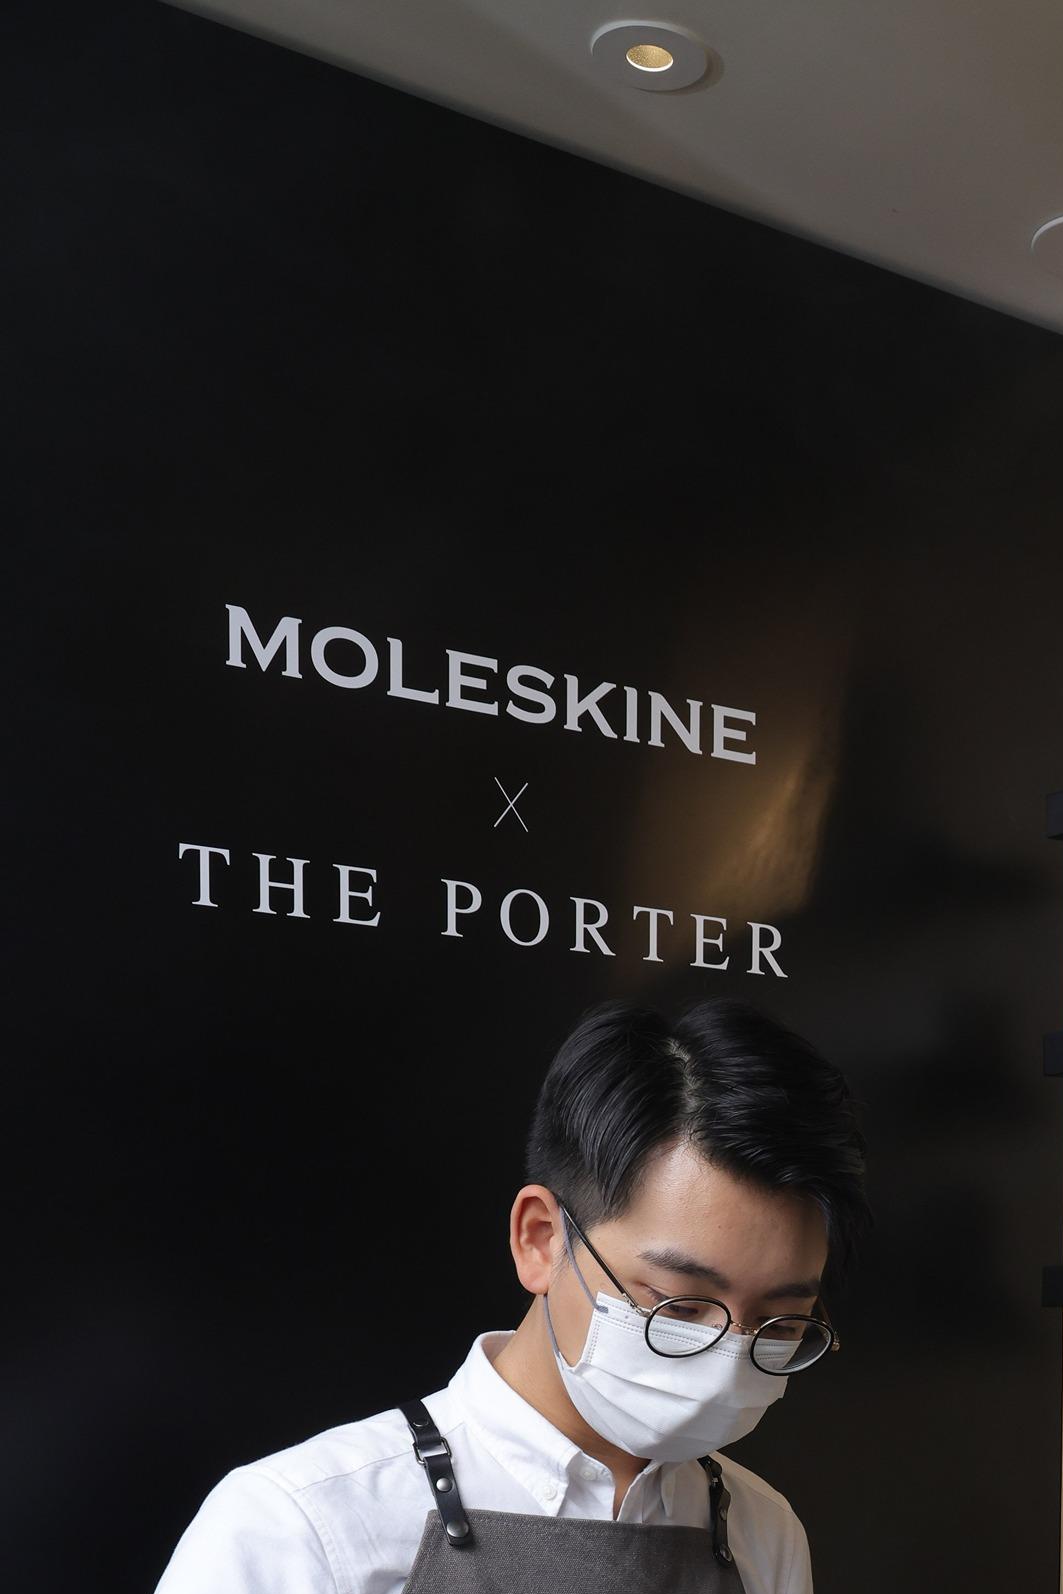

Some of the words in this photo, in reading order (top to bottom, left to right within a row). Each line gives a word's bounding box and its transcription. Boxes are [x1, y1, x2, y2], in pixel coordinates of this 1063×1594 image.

[225, 604, 756, 765] MOLESKINE
[179, 842, 381, 927] THE
[441, 878, 788, 978] PORTER
